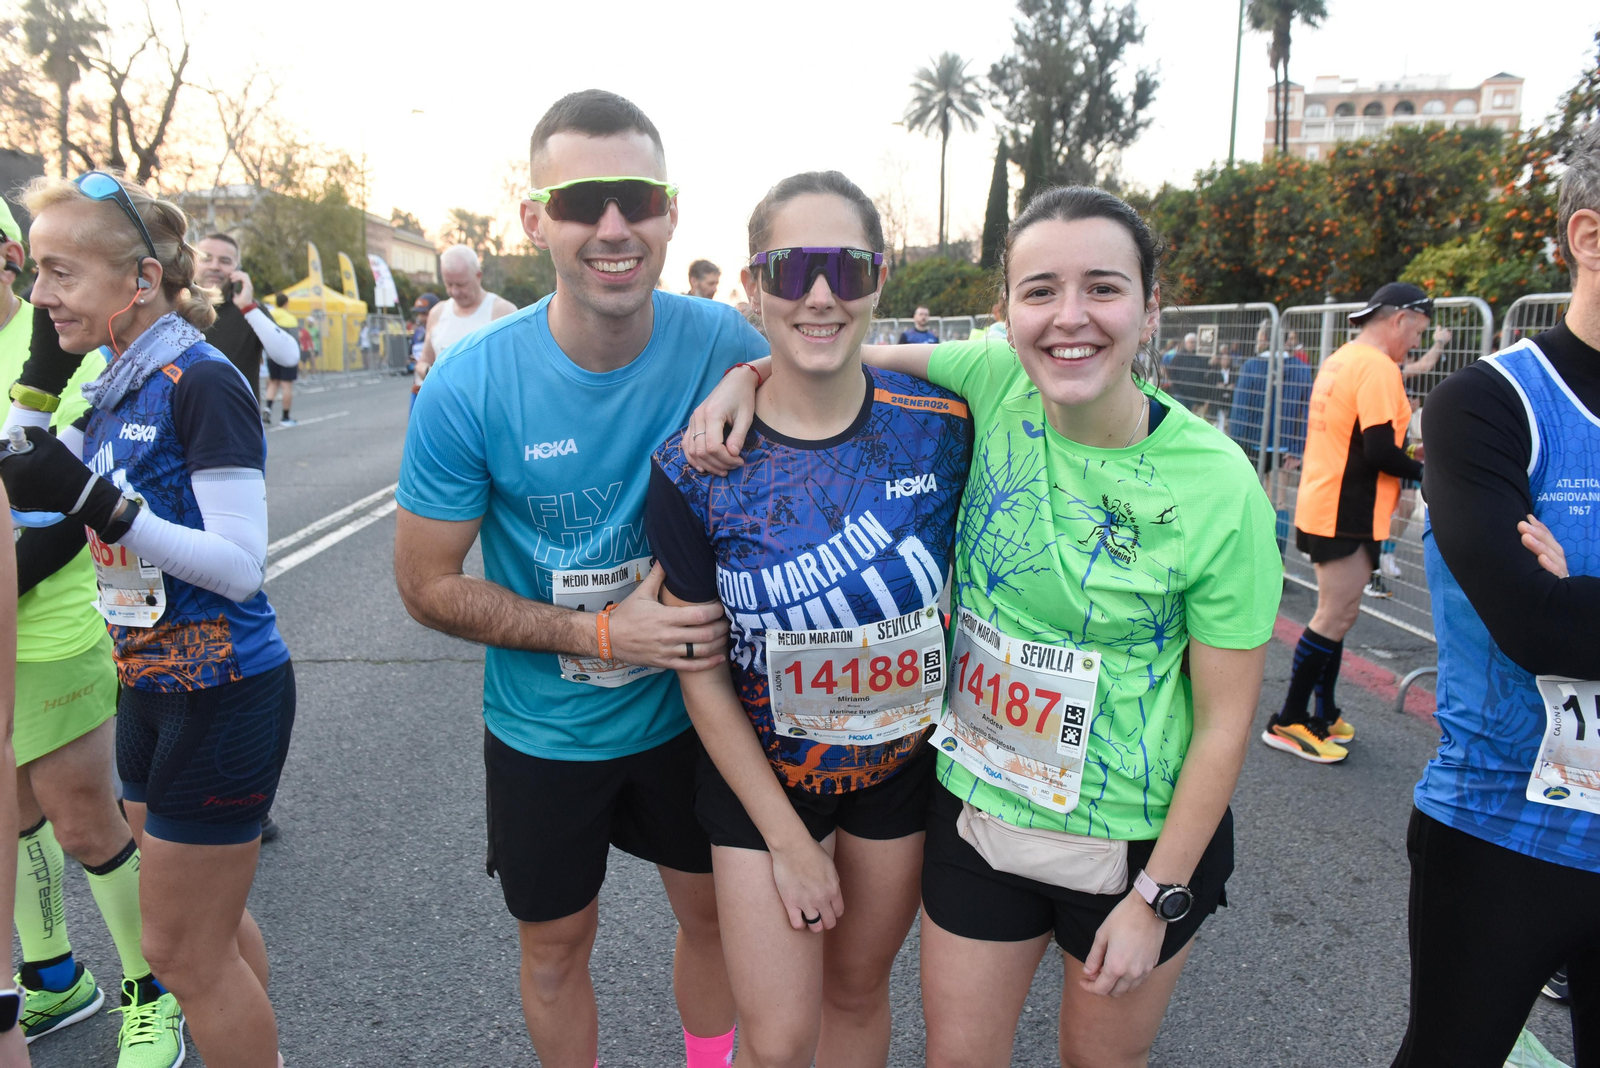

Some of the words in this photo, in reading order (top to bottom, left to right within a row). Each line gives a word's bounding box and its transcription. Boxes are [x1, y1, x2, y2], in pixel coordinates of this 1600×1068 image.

[891, 396, 950, 411] 28ENERO24
[119, 423, 157, 442] HOKA
[524, 438, 579, 461] HOKA
[885, 473, 938, 500] HOKA
[1555, 478, 1600, 489] ATLETICA
[527, 481, 623, 529] FLY
[1568, 505, 1591, 516] 1967
[761, 510, 893, 608] MARATÓN
[562, 574, 589, 588] MEDIO
[591, 567, 629, 586] MARATÓN
[777, 631, 806, 646] MEDIO
[809, 630, 853, 644] MARATÓN
[877, 611, 922, 641] SEVILLA
[976, 622, 1001, 651] MARATÓN
[1020, 643, 1075, 674] SEVILLA
[784, 648, 920, 695] 14188
[957, 651, 1062, 734] 14187
[981, 713, 1004, 731] Andrea
[1553, 711, 1562, 737] CAJÓN
[983, 764, 1003, 781] HOKA
